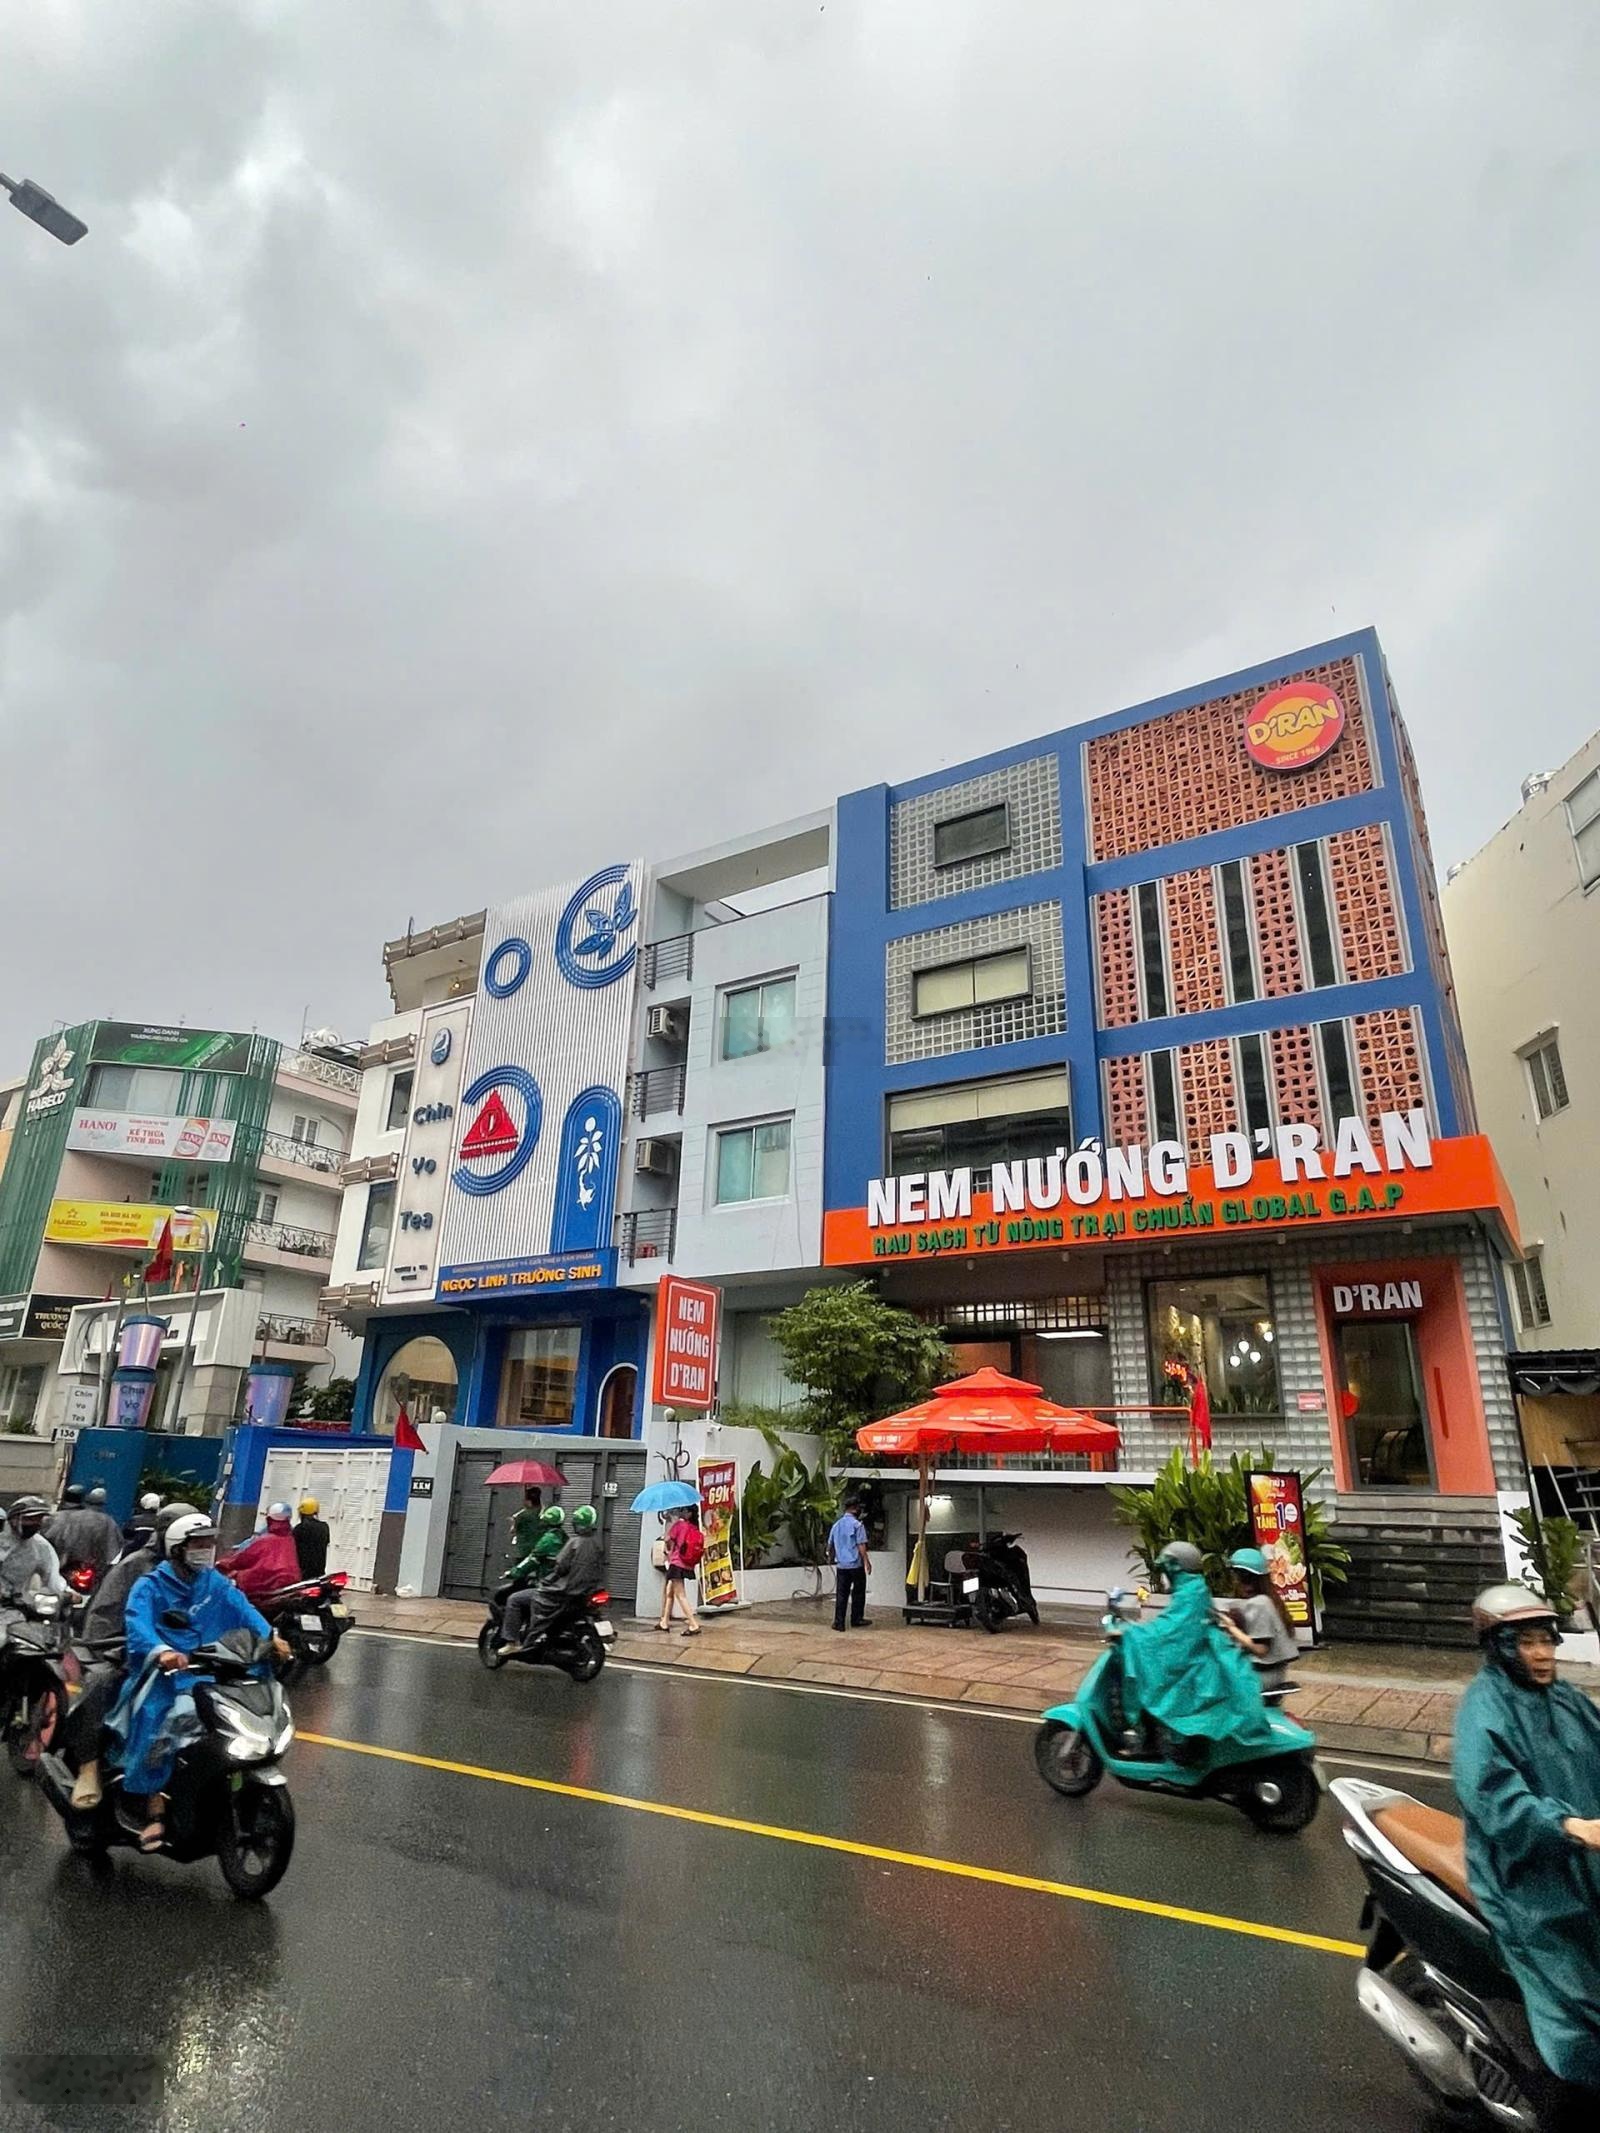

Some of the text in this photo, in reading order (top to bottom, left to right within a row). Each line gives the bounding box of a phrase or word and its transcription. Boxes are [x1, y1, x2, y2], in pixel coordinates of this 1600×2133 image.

[1247, 698, 1339, 746] D'RAN
[26, 1091, 67, 1113] HABECO
[413, 1101, 453, 1125] Chin
[79, 1119, 118, 1131] HANOI
[868, 1107, 1433, 1227] NEM NƯỚNG D'RAN
[401, 1211, 434, 1232] Tea
[874, 1233, 911, 1255] RAU
[916, 1228, 967, 1256] SẠCH
[1007, 1215, 1064, 1243] NÔNG
[1071, 1210, 1126, 1240] TRẠI
[1132, 1194, 1214, 1232] CHUẨN
[1221, 1191, 1321, 1224] GLOBAL
[441, 1277, 477, 1295] NGỌC
[478, 1274, 508, 1289] LINH
[511, 1266, 566, 1285] TRƯỜNG
[568, 1264, 602, 1281] SINH
[678, 1296, 705, 1325] NEM
[1333, 1280, 1423, 1313] D'RAN
[669, 1326, 710, 1358] NƯỚNG
[670, 1362, 706, 1392] D'RAN
[74, 1390, 93, 1398] Chin
[72, 1413, 86, 1422] Tea
[60, 1429, 75, 1438] 136
